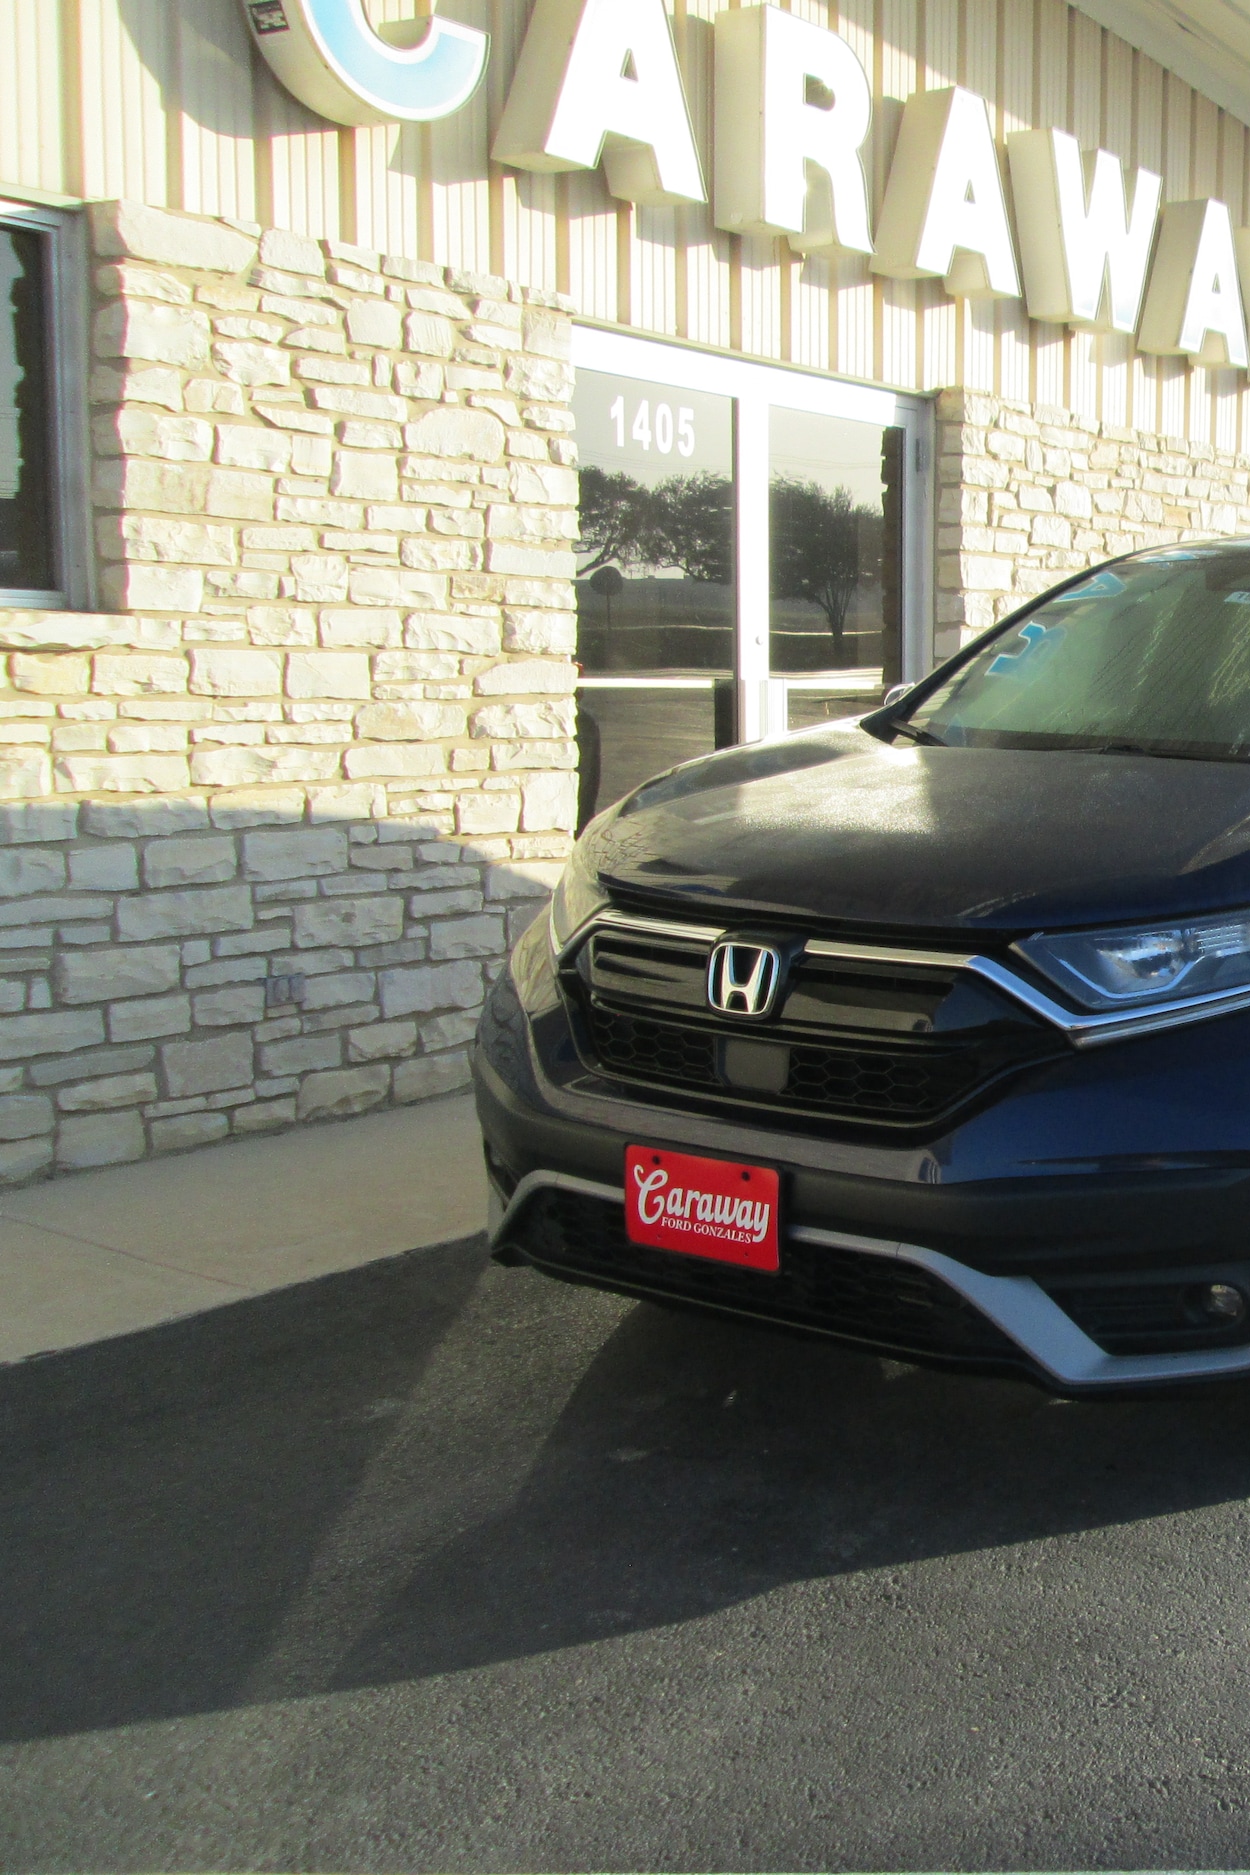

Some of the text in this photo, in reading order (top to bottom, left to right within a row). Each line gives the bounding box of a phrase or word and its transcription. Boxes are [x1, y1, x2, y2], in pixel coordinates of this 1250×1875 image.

[610, 395, 695, 457] 1405
[633, 1164, 770, 1243] Caraway
[661, 1216, 752, 1244] FORD GONZALES
